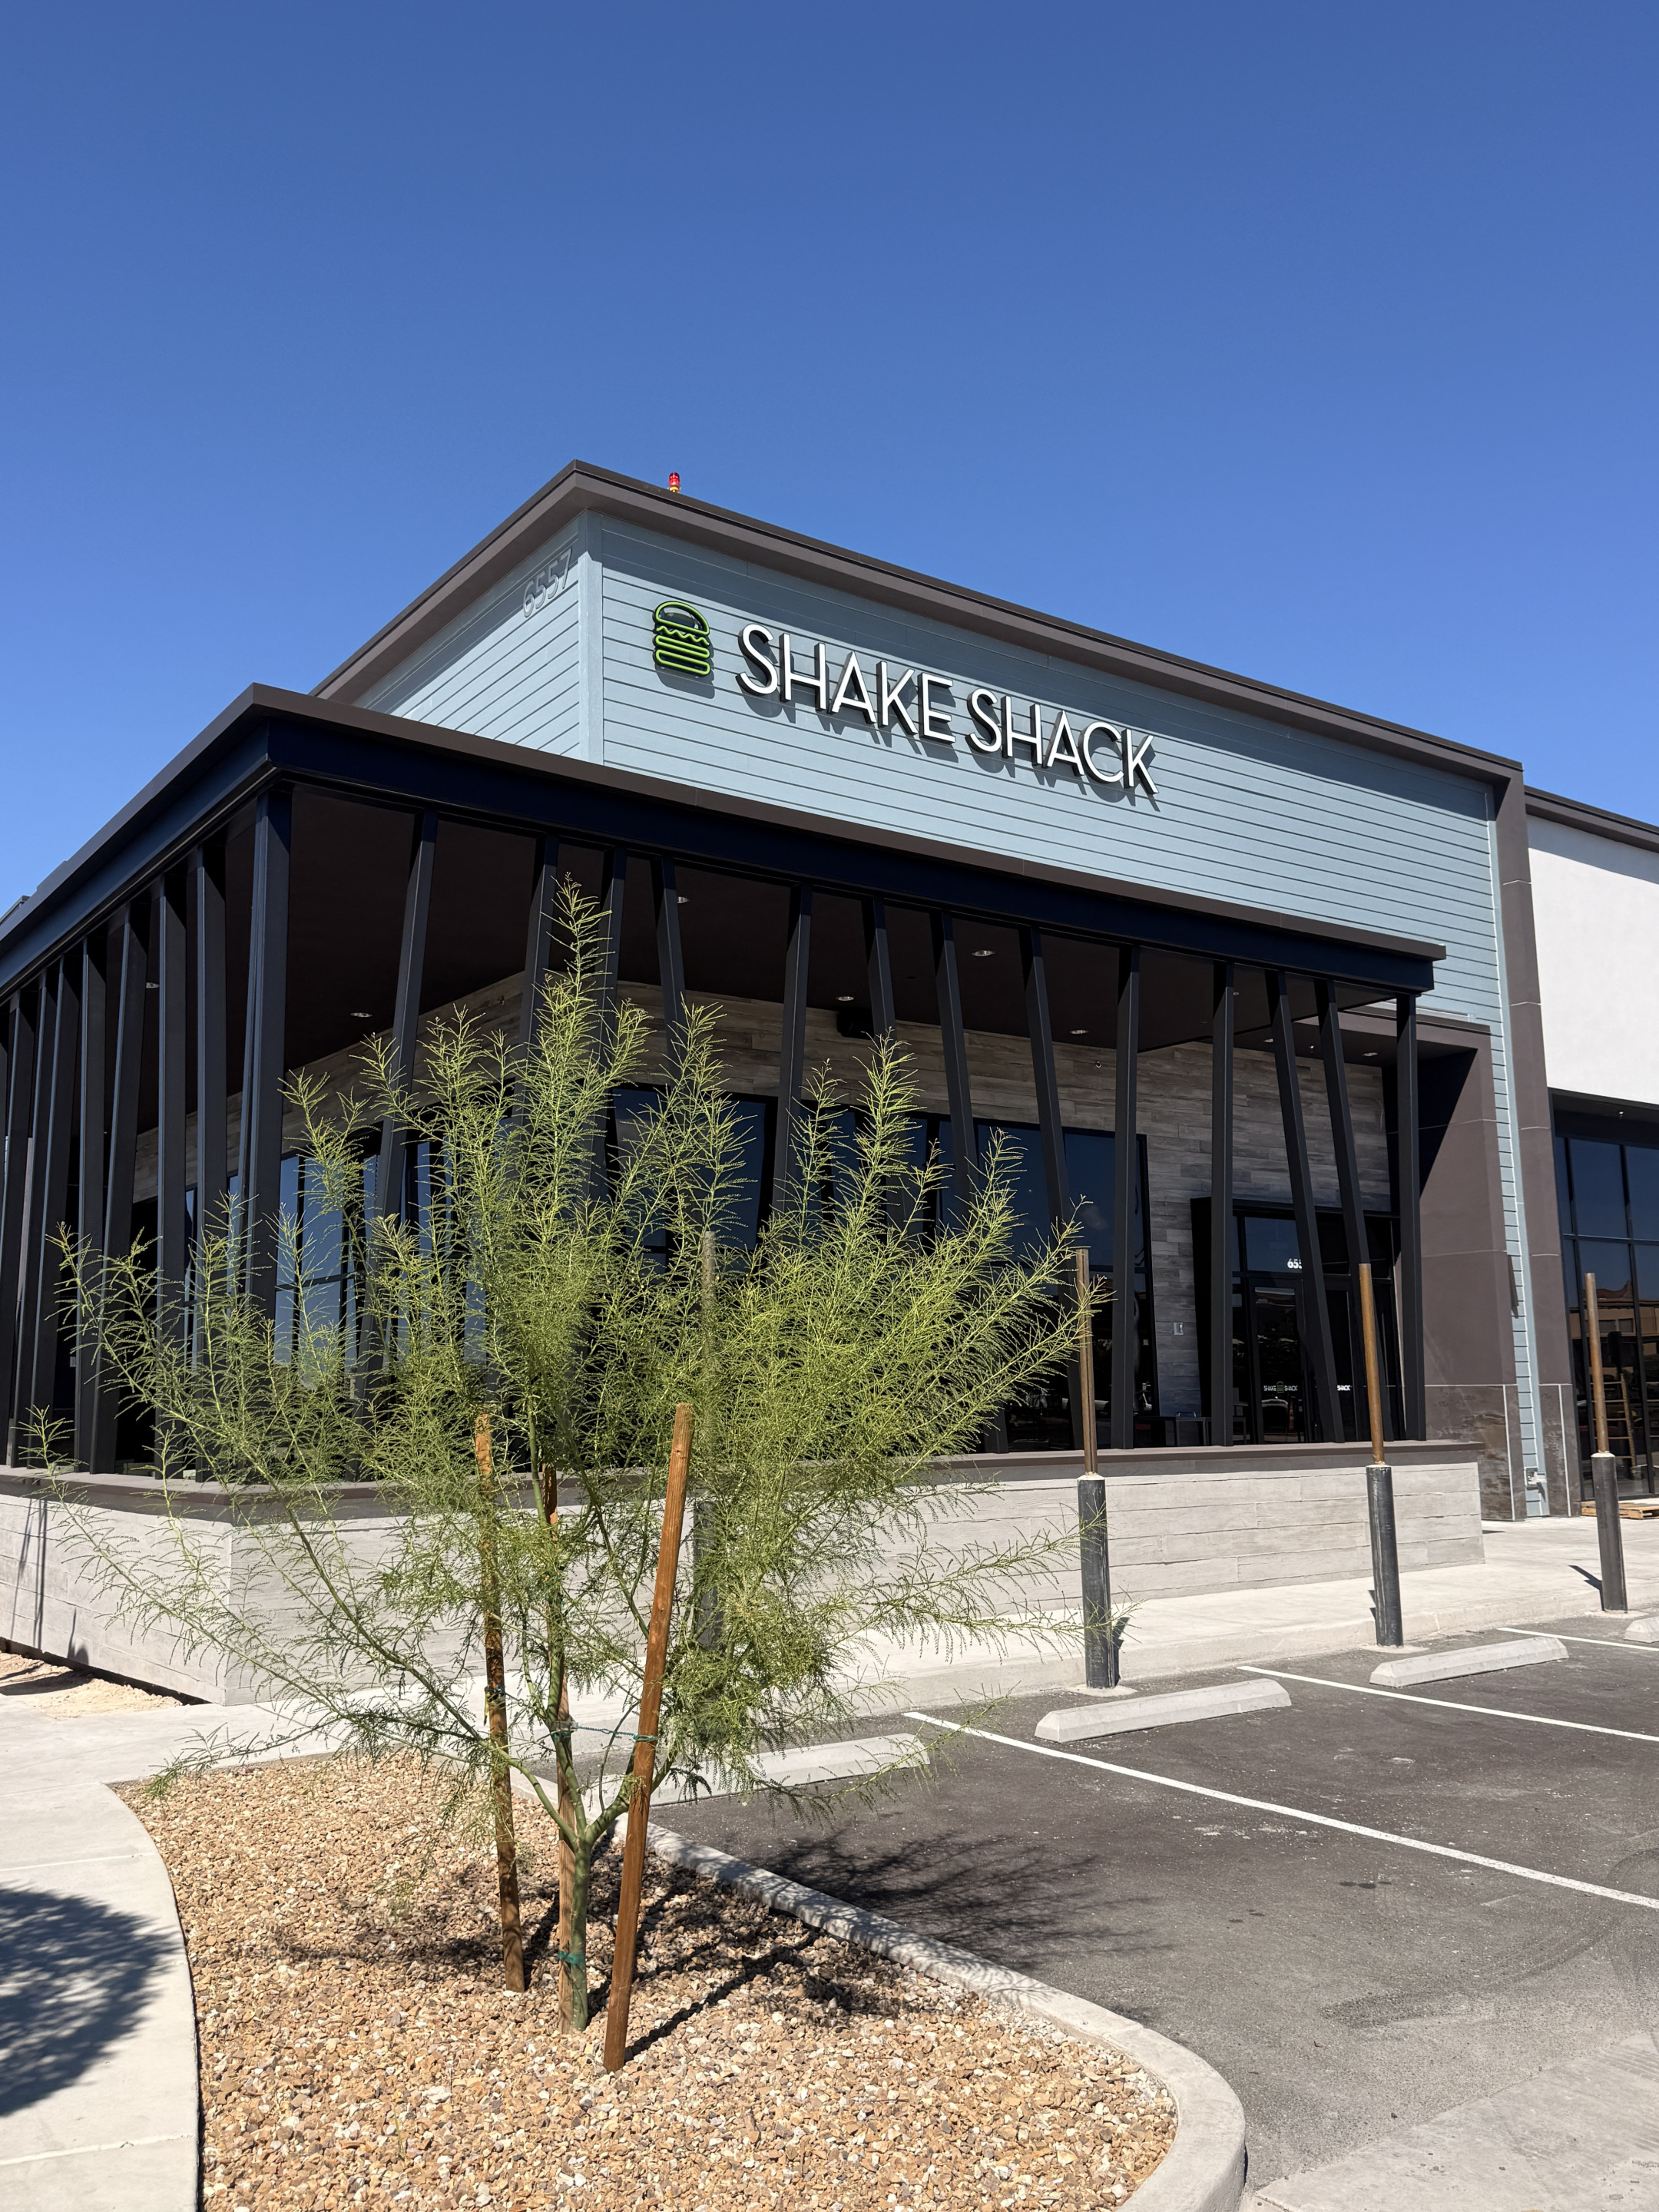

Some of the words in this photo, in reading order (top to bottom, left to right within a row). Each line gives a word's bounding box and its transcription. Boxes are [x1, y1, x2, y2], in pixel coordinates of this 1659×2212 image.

[523, 545, 572, 618] 6557
[735, 623, 956, 744] SHAKE
[965, 688, 1161, 795] SHACK
